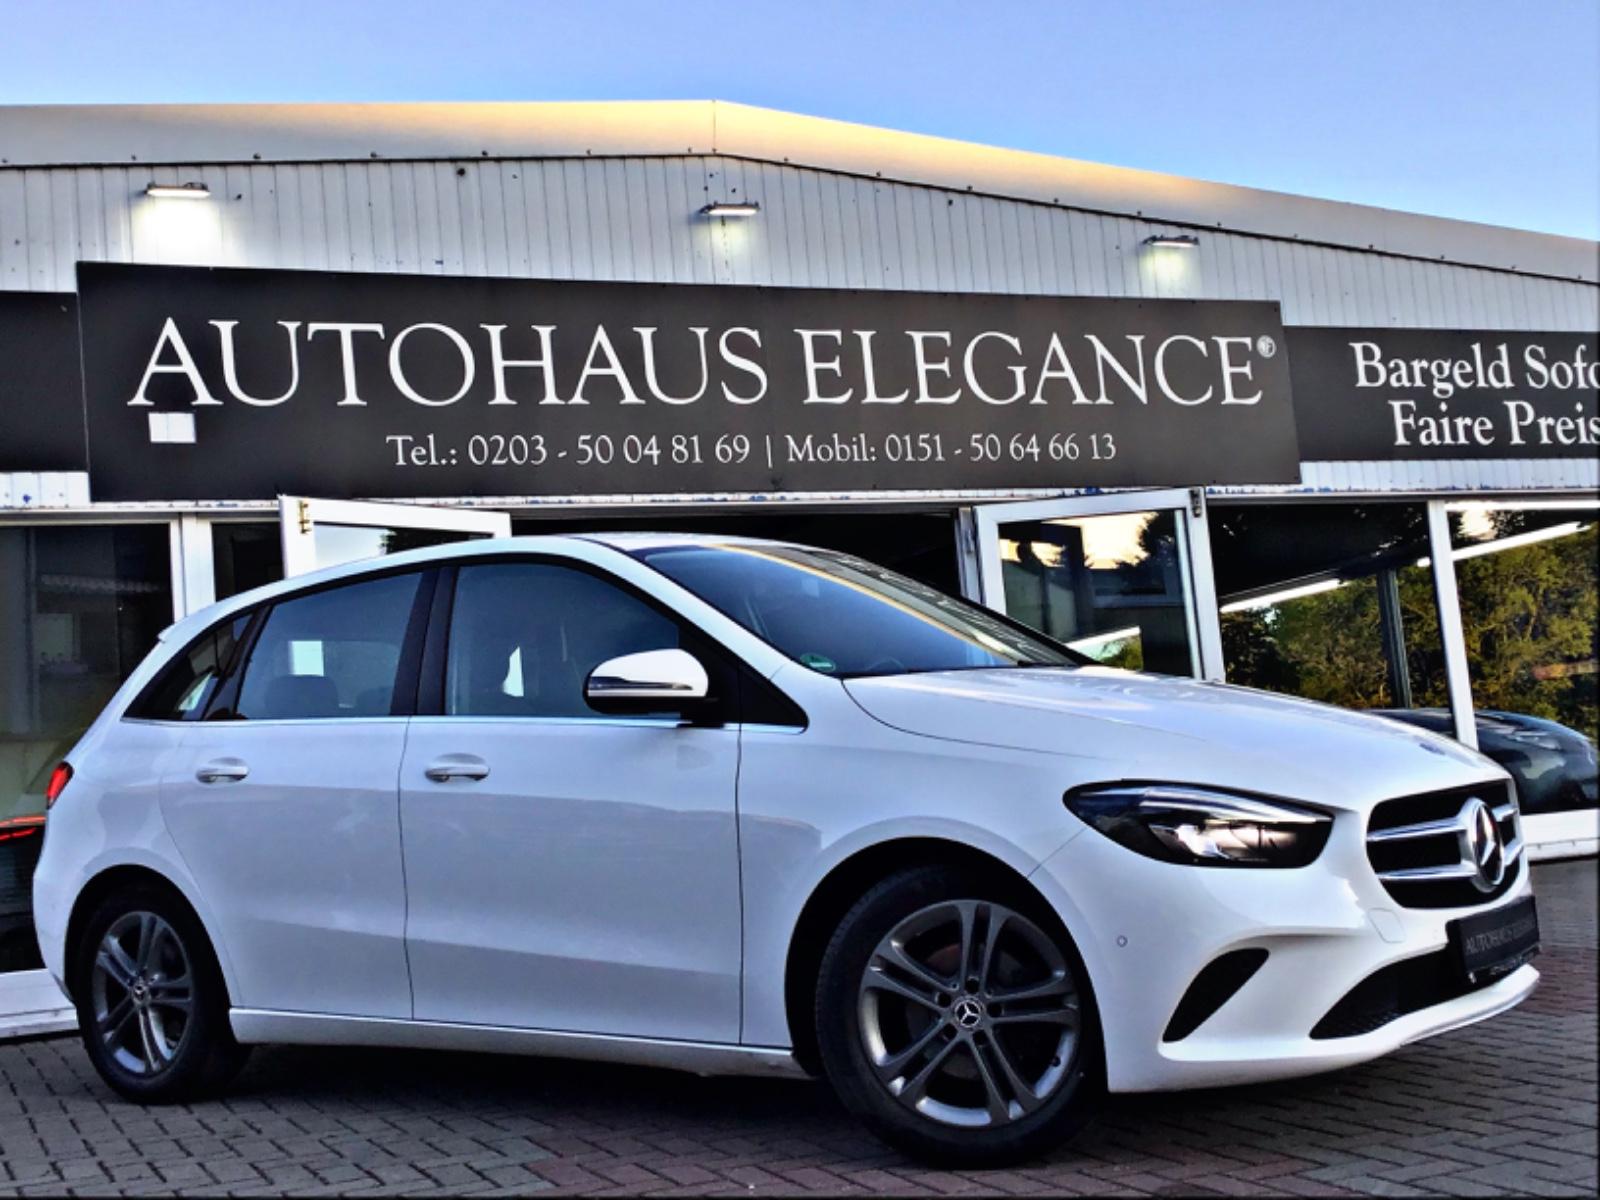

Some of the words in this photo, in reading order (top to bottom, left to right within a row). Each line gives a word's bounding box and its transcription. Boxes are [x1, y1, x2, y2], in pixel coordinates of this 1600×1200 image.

[126, 316, 768, 407] AUTOHAUS
[1348, 341, 1515, 399] Bargeld
[1388, 399, 1495, 446] Faire
[385, 434, 458, 467] Tel.:
[468, 434, 548, 466] 0203
[576, 434, 615, 466] 50
[622, 434, 662, 466] 04
[671, 434, 704, 465] 81
[714, 433, 751, 465] 69
[783, 432, 877, 463] Mobil:
[884, 432, 946, 463] 0151
[969, 432, 1002, 463] 50
[1009, 432, 1041, 463] 64
[1048, 432, 1080, 462] 66
[1089, 432, 1118, 461] 13
